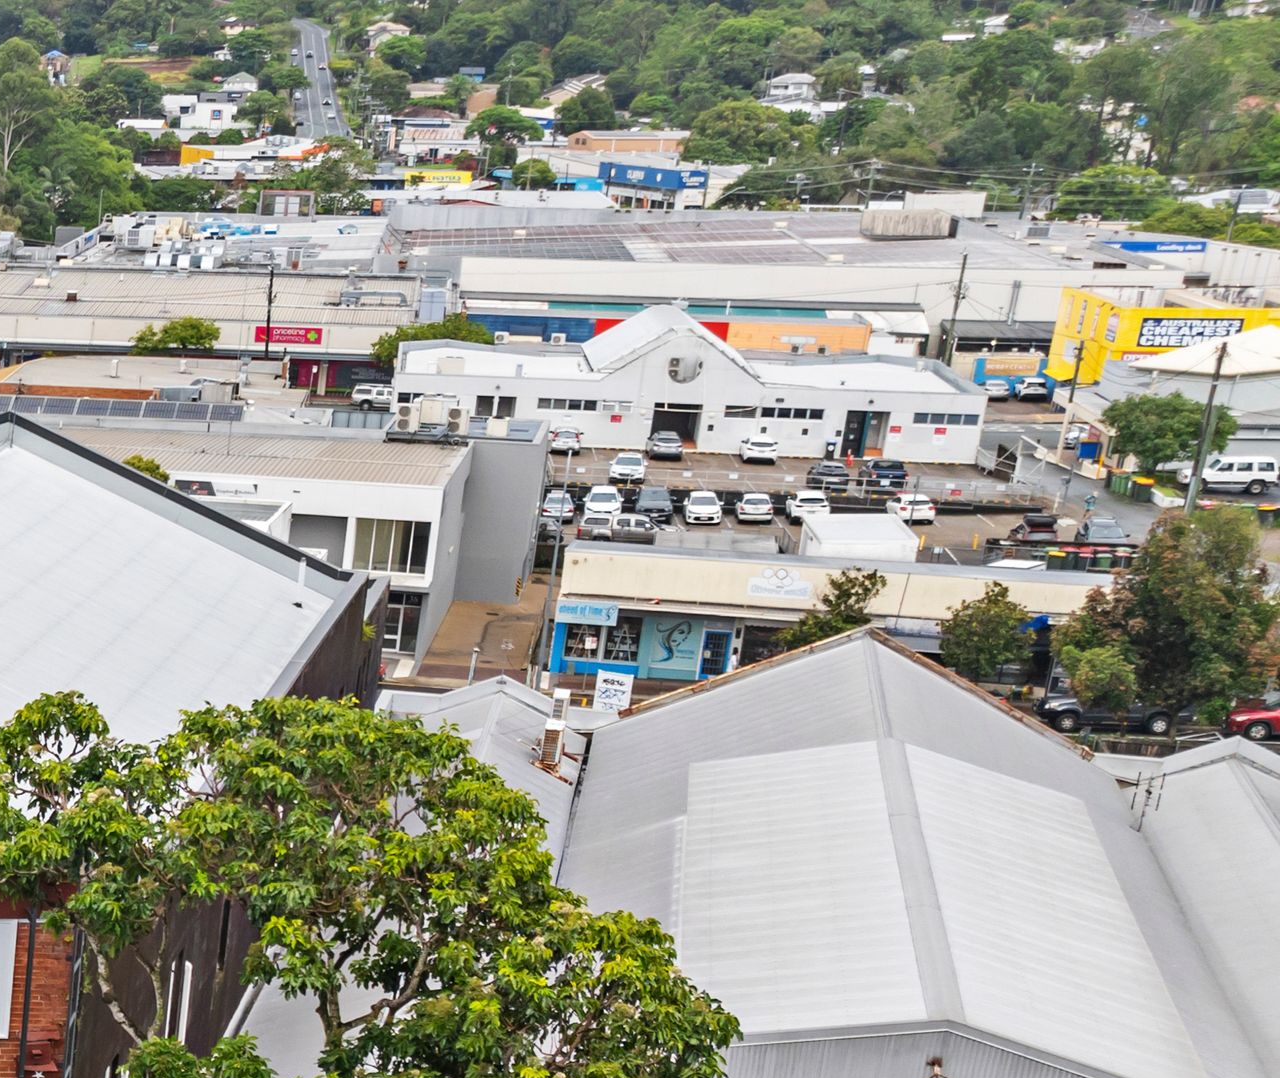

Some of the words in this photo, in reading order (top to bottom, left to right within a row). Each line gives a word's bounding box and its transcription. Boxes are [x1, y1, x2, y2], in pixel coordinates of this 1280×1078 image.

[1160, 319, 1241, 327] AUSTRALIA'S
[1141, 326, 1239, 336] CHEAPEST
[1140, 335, 1216, 347] CHEM
